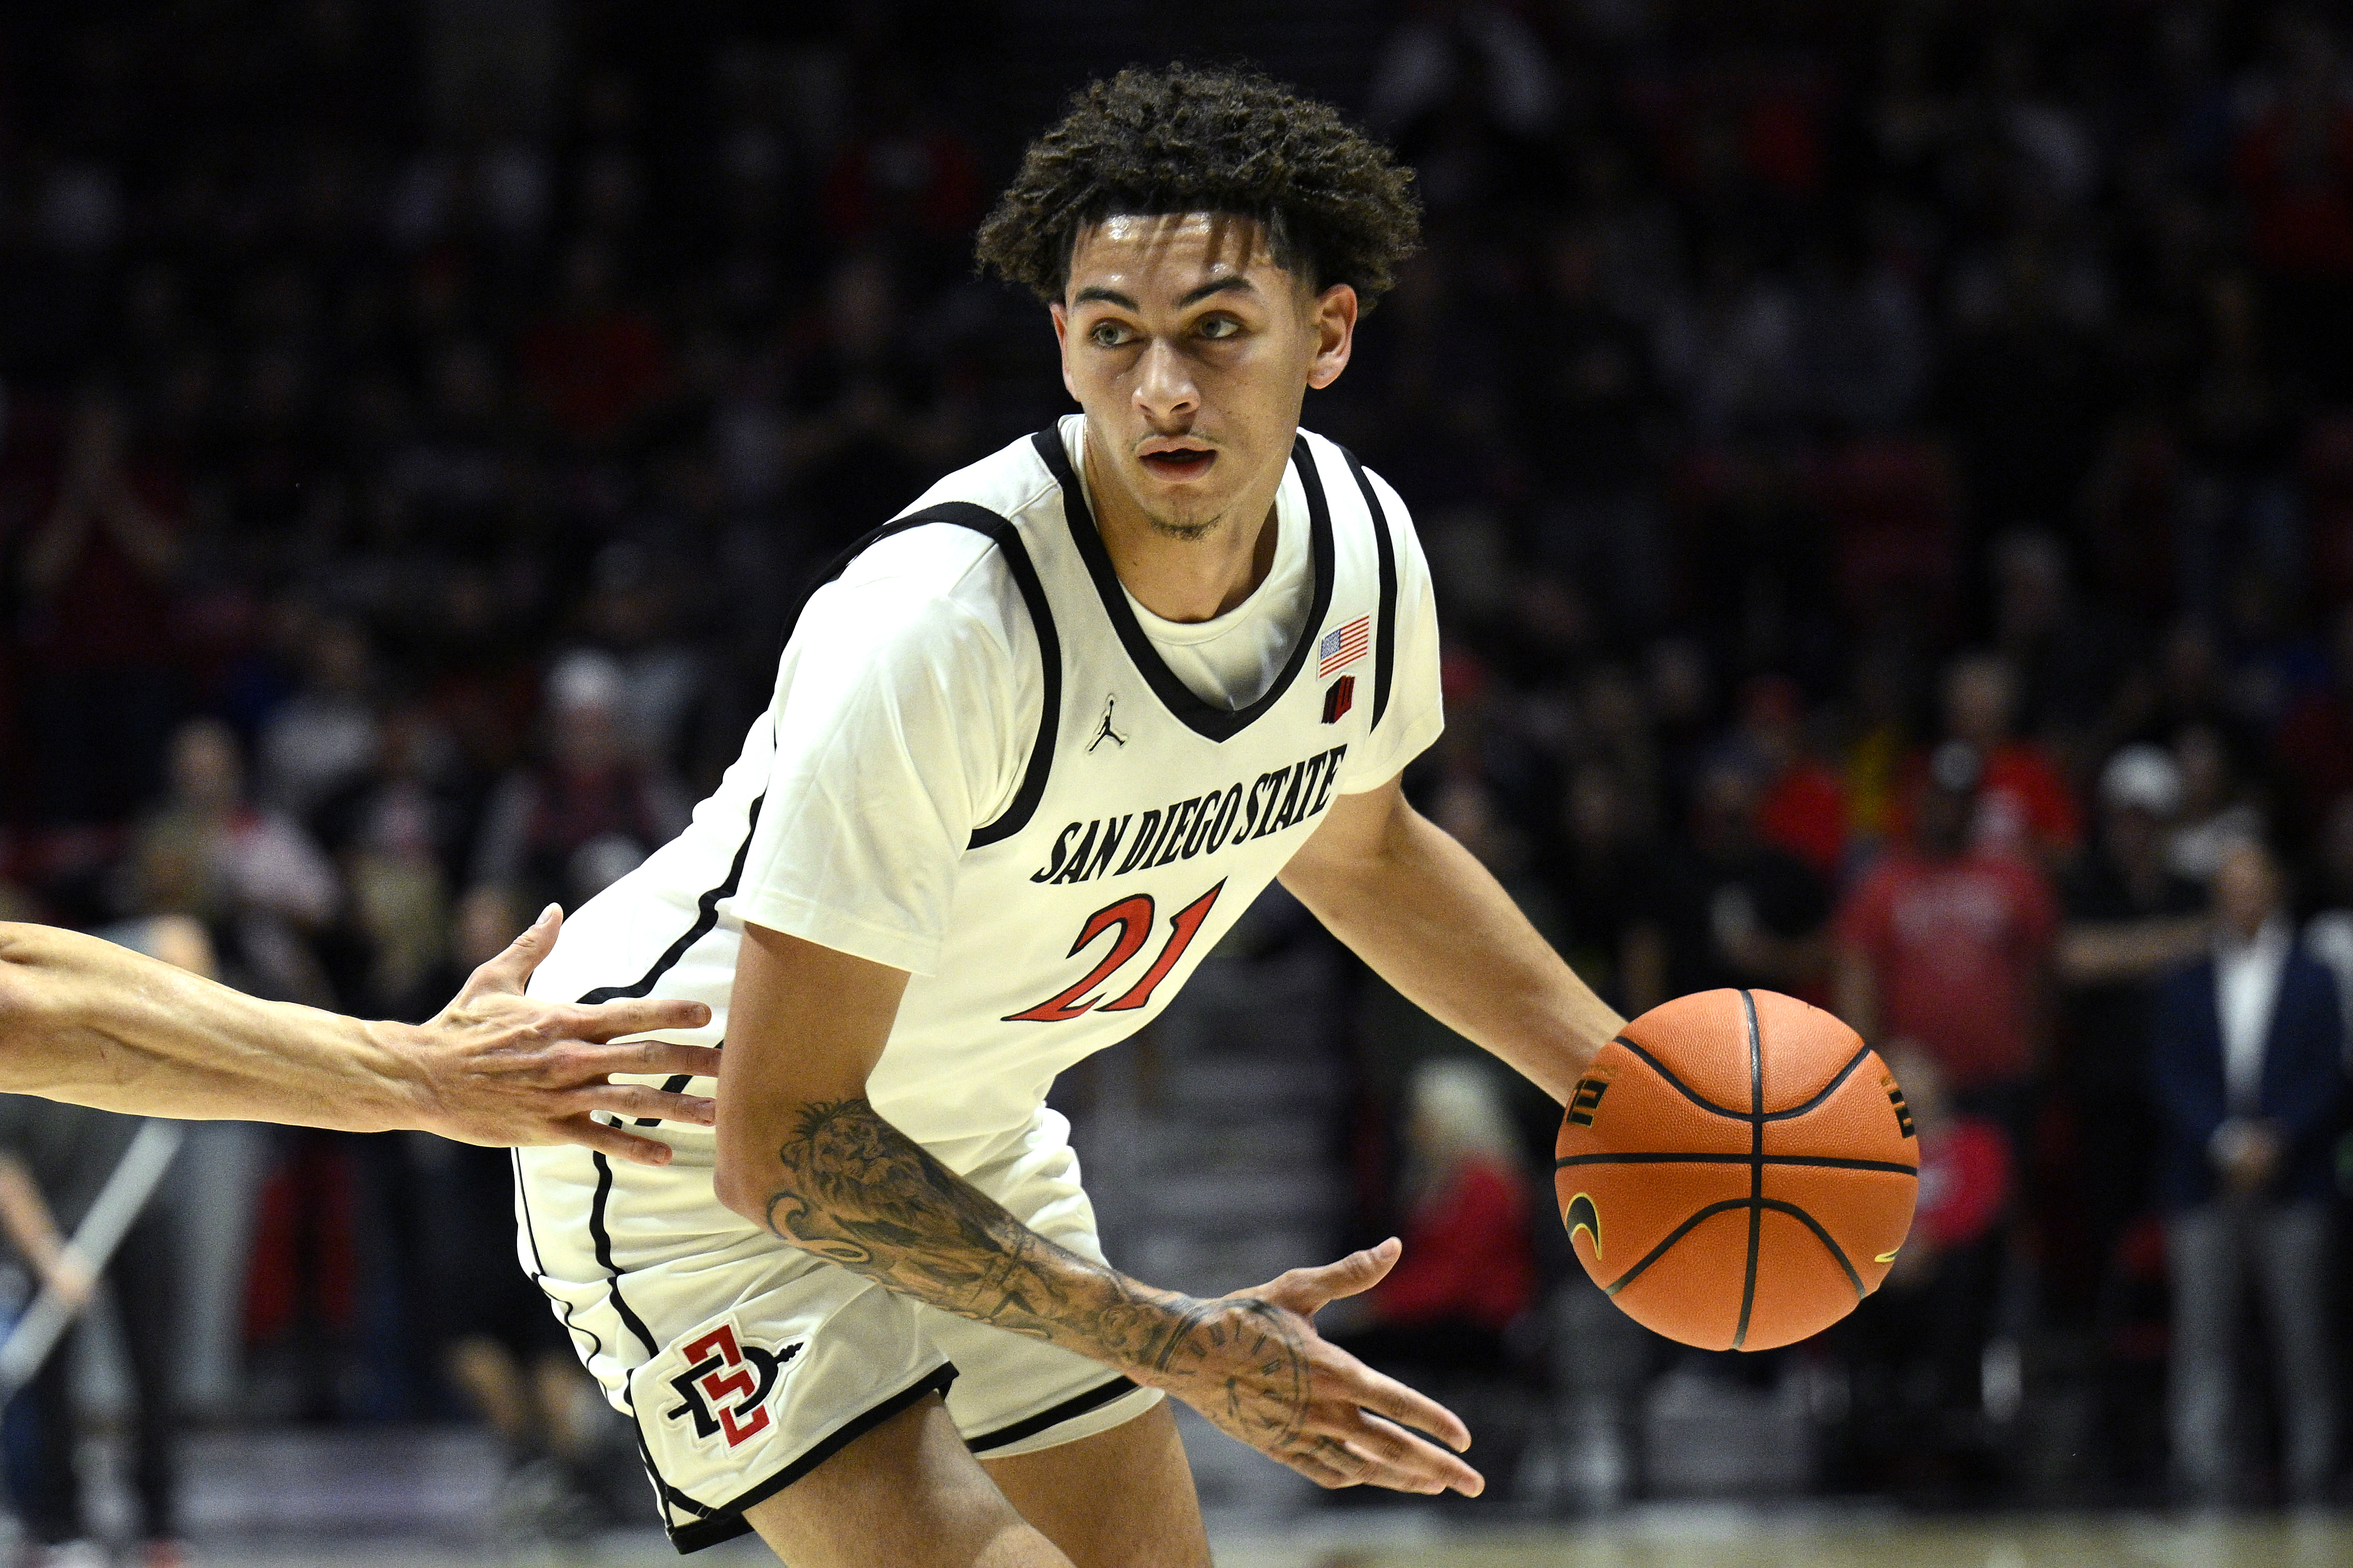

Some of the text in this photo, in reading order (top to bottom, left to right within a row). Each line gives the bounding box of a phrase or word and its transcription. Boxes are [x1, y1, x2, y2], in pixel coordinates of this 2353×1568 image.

[1030, 743, 1347, 885] SAN DIEGO STATE
[1000, 876, 1229, 1022] 21
